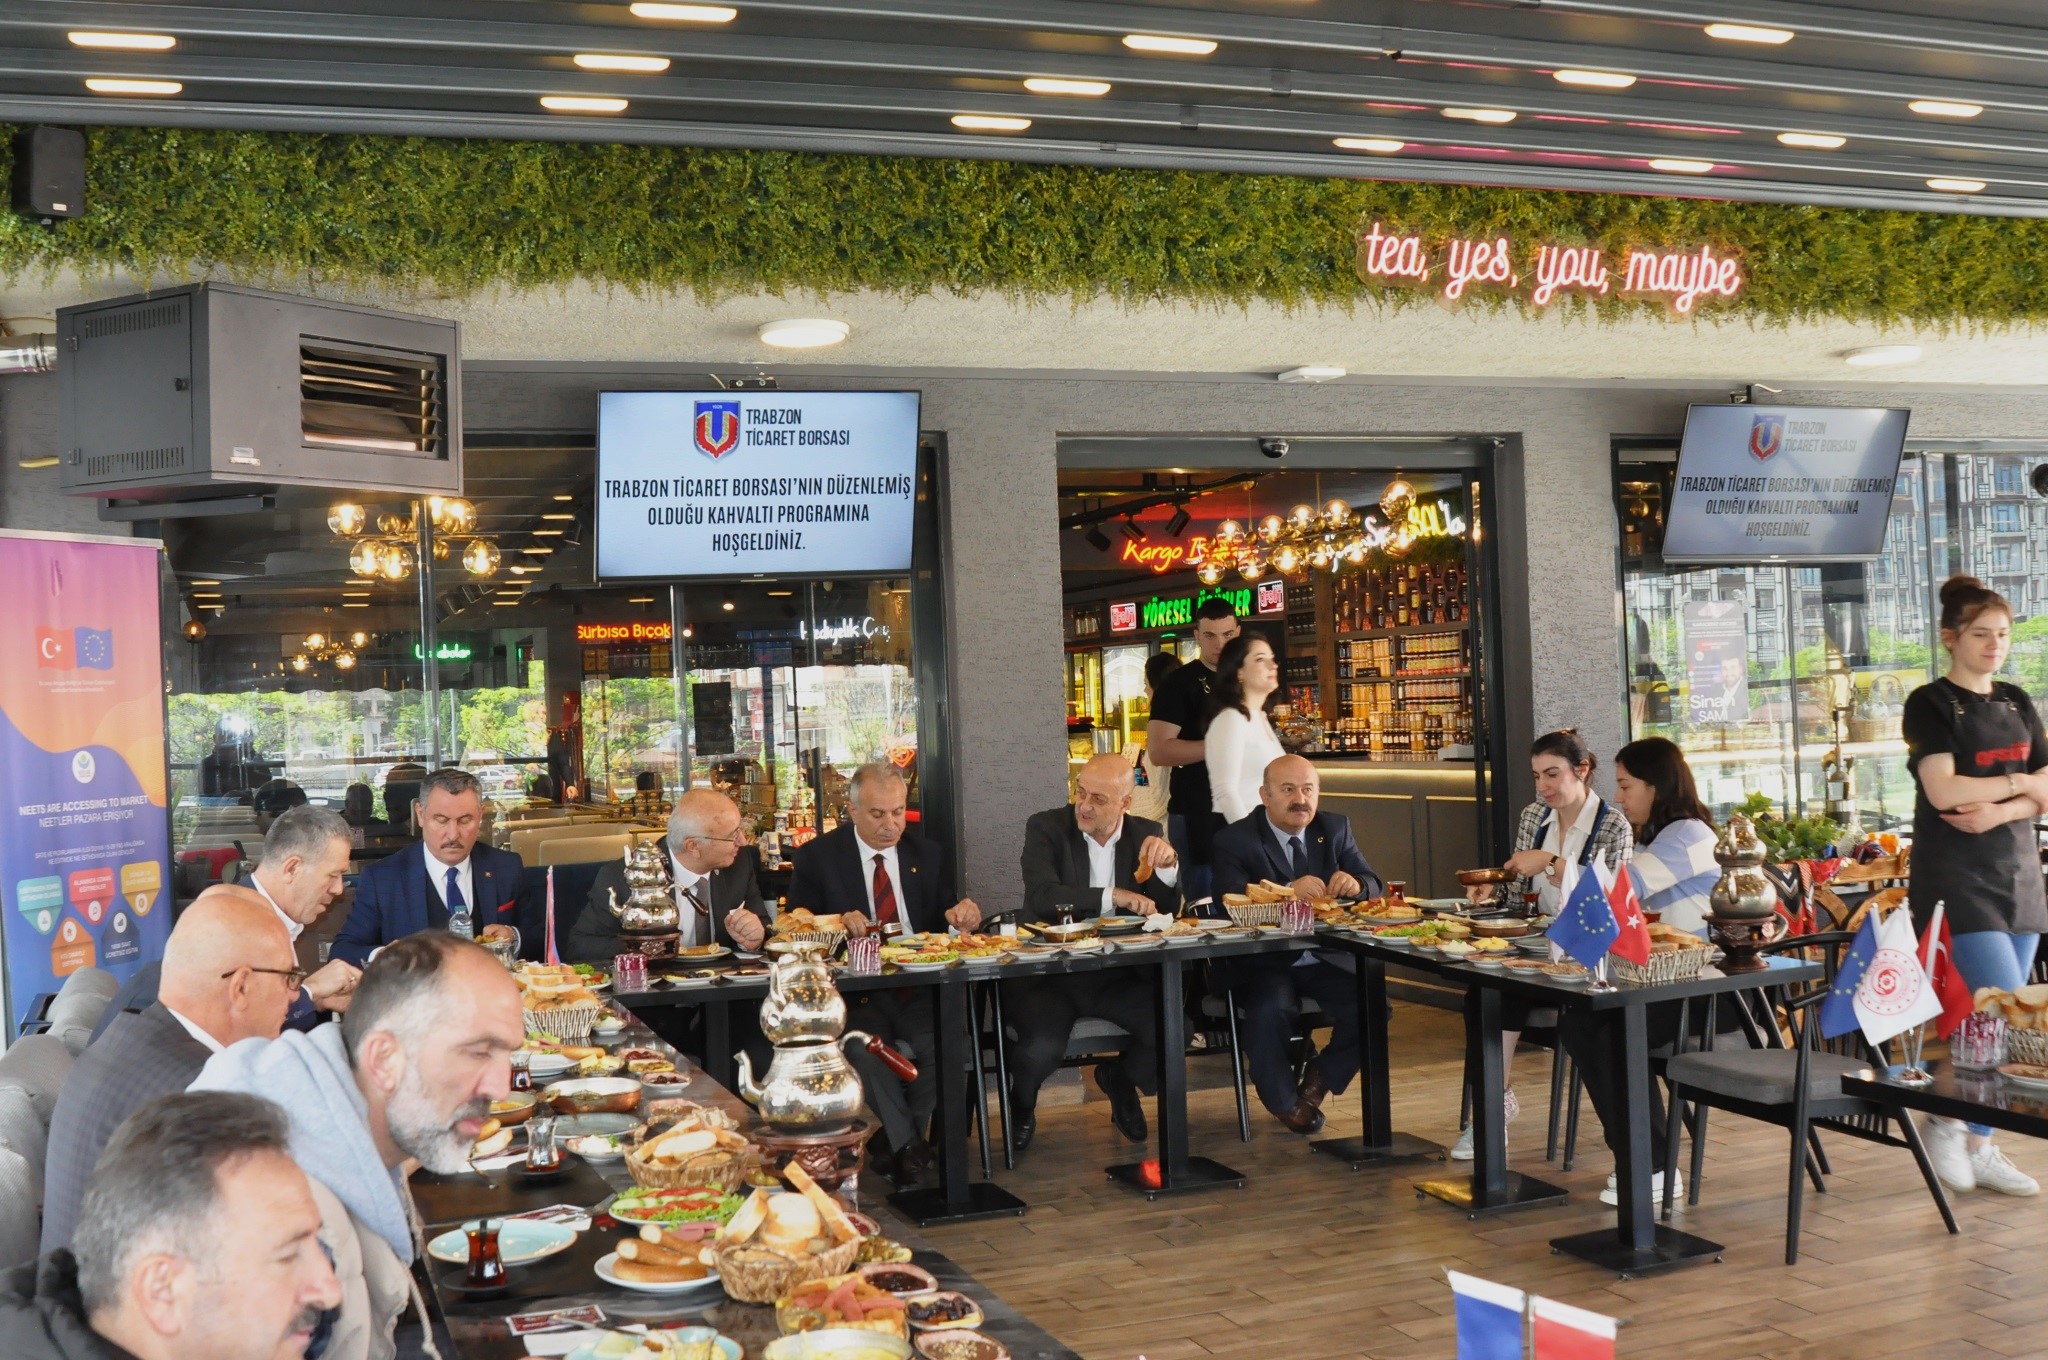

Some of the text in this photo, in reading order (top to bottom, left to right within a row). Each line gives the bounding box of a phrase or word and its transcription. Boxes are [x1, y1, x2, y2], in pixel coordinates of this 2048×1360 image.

[1365, 222, 1740, 312] tea, yes, you, maybe
[746, 409, 801, 425] TRABZON
[746, 428, 850, 446] TİCARET BORSASI
[1787, 421, 1827, 435] TRABZON
[1784, 438, 1857, 452] TİCARET BORSASI
[605, 473, 911, 499] TRABZON TİCARET BORSASI'NIN DÜZENLEMİŞ
[1680, 474, 1892, 497] TRABZON TİCARET BORSASI'NIN DÜZENLEMİŞ
[648, 503, 870, 525] OLDUĞU KAHVALTI PROGRAMINA
[1705, 498, 1859, 515] OLDUĞU KAHVALTI PROGRAMINA
[1745, 519, 1811, 541] HOŞGELDİNİZ.
[713, 529, 806, 557] HOŞGELDİNİZ.
[1123, 538, 1183, 572] Kargo
[1143, 597, 1192, 628] YÖRESEL
[632, 623, 671, 638] Bıçak
[1690, 694, 1735, 709] Sinan
[19, 795, 148, 816] NEETS ARE ACCESSING TO MARKET
[73, 812, 102, 824] PAZARA
